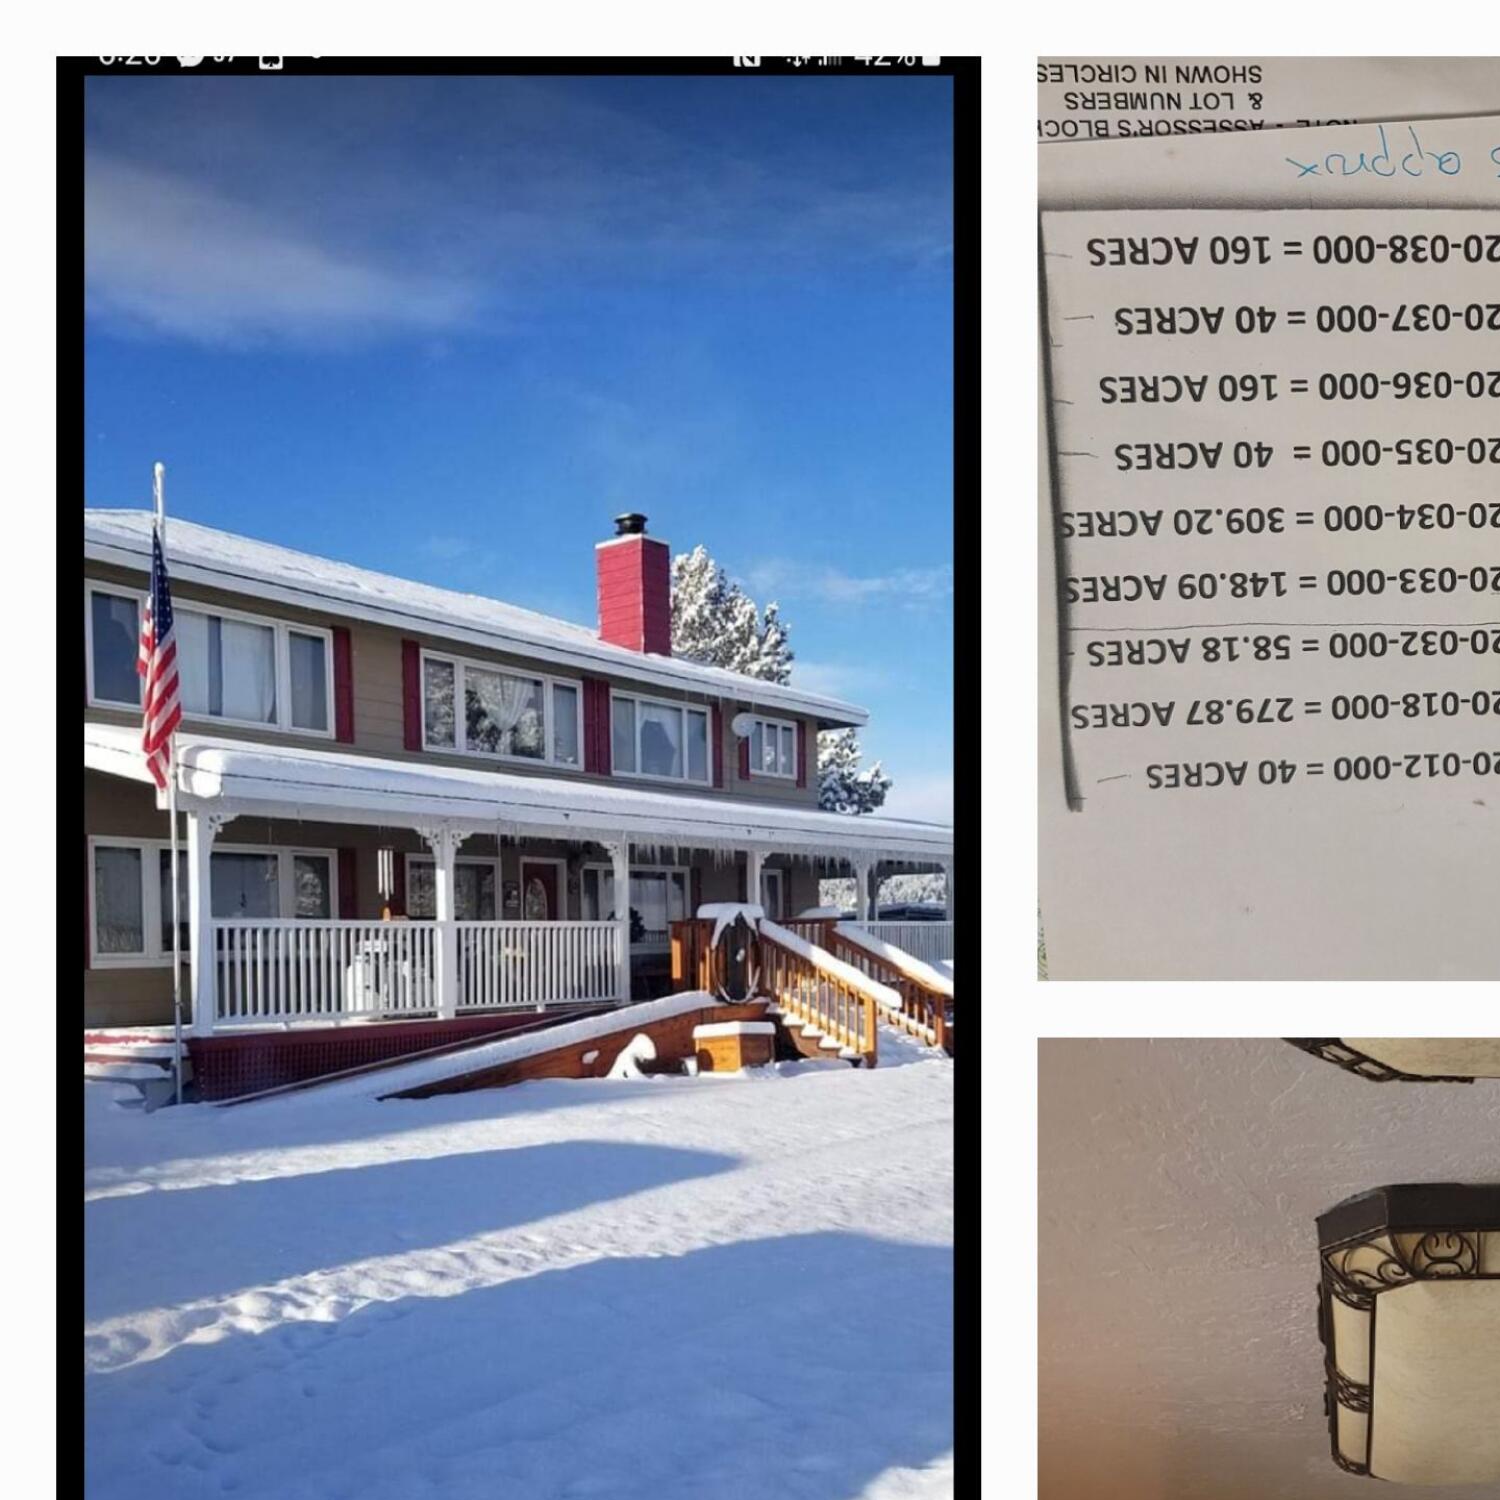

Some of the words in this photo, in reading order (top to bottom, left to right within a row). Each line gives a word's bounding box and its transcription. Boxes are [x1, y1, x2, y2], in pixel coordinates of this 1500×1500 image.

[1037, 64, 1137, 84] CIRCLES
[1145, 64, 1167, 83] IN
[1176, 64, 1262, 84] SHOWN
[1064, 92, 1182, 110] NUMBERS
[1189, 92, 1235, 110] LOT
[1249, 91, 1263, 110] &
[1286, 124, 1461, 178] approx
[1087, 236, 1199, 267] ACRES
[1210, 236, 1271, 265] 160
[1115, 306, 1225, 336] ACRES
[1235, 306, 1277, 334] 40
[1099, 375, 1208, 404] ACRES
[1218, 374, 1278, 402] 160
[1115, 441, 1223, 471] ACRES
[1233, 441, 1274, 469] 40
[1061, 510, 1163, 538] ACRES
[1173, 507, 1285, 536] 309.20
[1066, 574, 1167, 603] ACRES
[1178, 571, 1287, 600] 148.09
[1086, 638, 1191, 667] ACRES
[1201, 635, 1290, 663] 58.18
[1071, 701, 1175, 729] ACRES
[1186, 697, 1294, 725] 279.87
[1146, 761, 1248, 789] ACRES
[1258, 760, 1297, 785] 40
